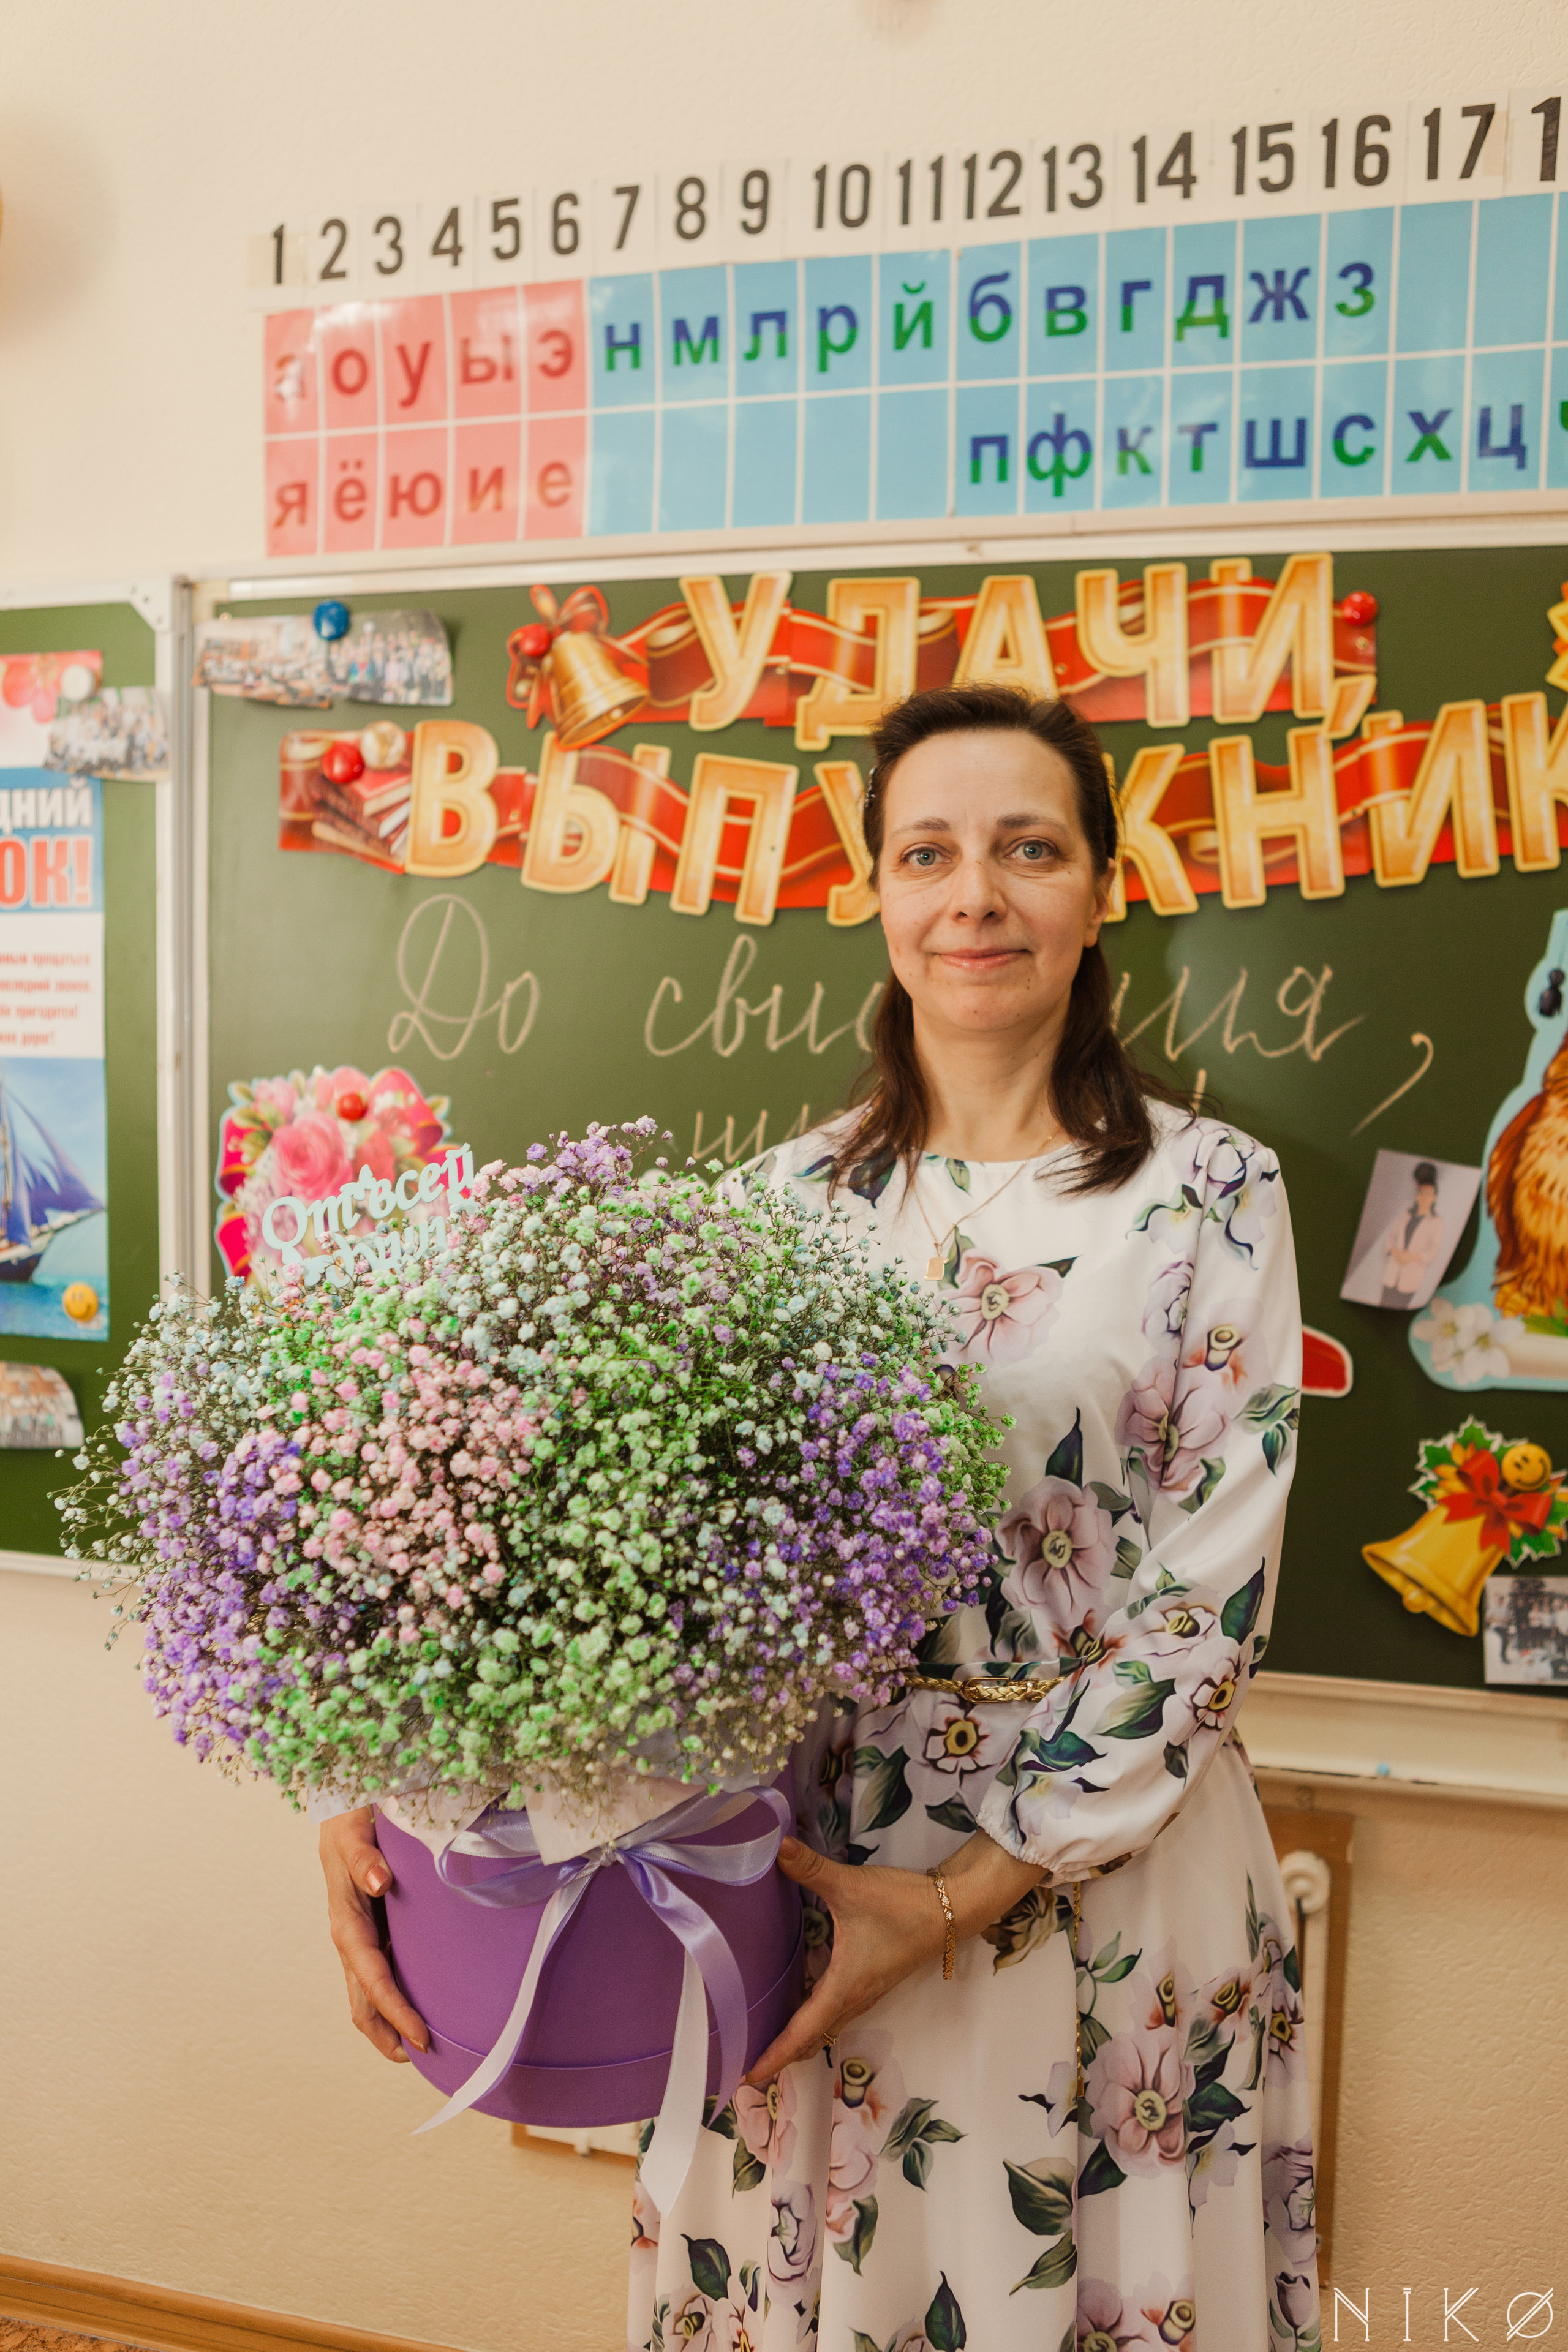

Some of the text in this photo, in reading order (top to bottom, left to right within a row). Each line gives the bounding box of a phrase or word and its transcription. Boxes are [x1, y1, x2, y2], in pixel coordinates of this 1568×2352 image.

[273, 224, 284, 285] 1
[320, 218, 347, 280] 2
[374, 216, 404, 275] 3
[432, 206, 463, 267] 4
[492, 198, 521, 260] 5
[552, 192, 579, 255] 6
[614, 185, 640, 250] 7
[675, 176, 707, 241] 8
[741, 169, 770, 235] 9
[813, 164, 872, 230] 10
[898, 155, 944, 226] 11
[963, 149, 1023, 221] 12
[1042, 143, 1104, 210] 13
[1131, 131, 1197, 200] 14
[1231, 121, 1295, 196] 15
[1321, 114, 1392, 189] 16
[1423, 102, 1496, 181] 17
[331, 347, 368, 394] о
[396, 341, 432, 409] у
[460, 336, 514, 385] ы
[538, 330, 575, 379] э
[604, 322, 643, 373] н
[671, 314, 721, 368] м
[742, 308, 789, 363] л
[816, 303, 860, 375] р
[892, 280, 935, 353] й
[967, 270, 1014, 345] б
[1044, 283, 1090, 339] в
[1118, 277, 1155, 334] г
[1174, 272, 1231, 343] д
[1246, 265, 1313, 325] ж
[1333, 260, 1377, 320] з
[273, 481, 307, 527] я
[333, 458, 368, 522] ё
[388, 470, 443, 519] ю
[467, 465, 506, 513] и
[536, 458, 574, 509] е
[968, 432, 1011, 486] п
[1025, 412, 1094, 499] ф
[1116, 425, 1155, 477] к
[1178, 423, 1221, 475] т
[1243, 415, 1310, 472] ш
[1329, 412, 1378, 469] с
[1403, 407, 1454, 465] х
[1476, 402, 1529, 472] ц
[388, 893, 540, 1060] До
